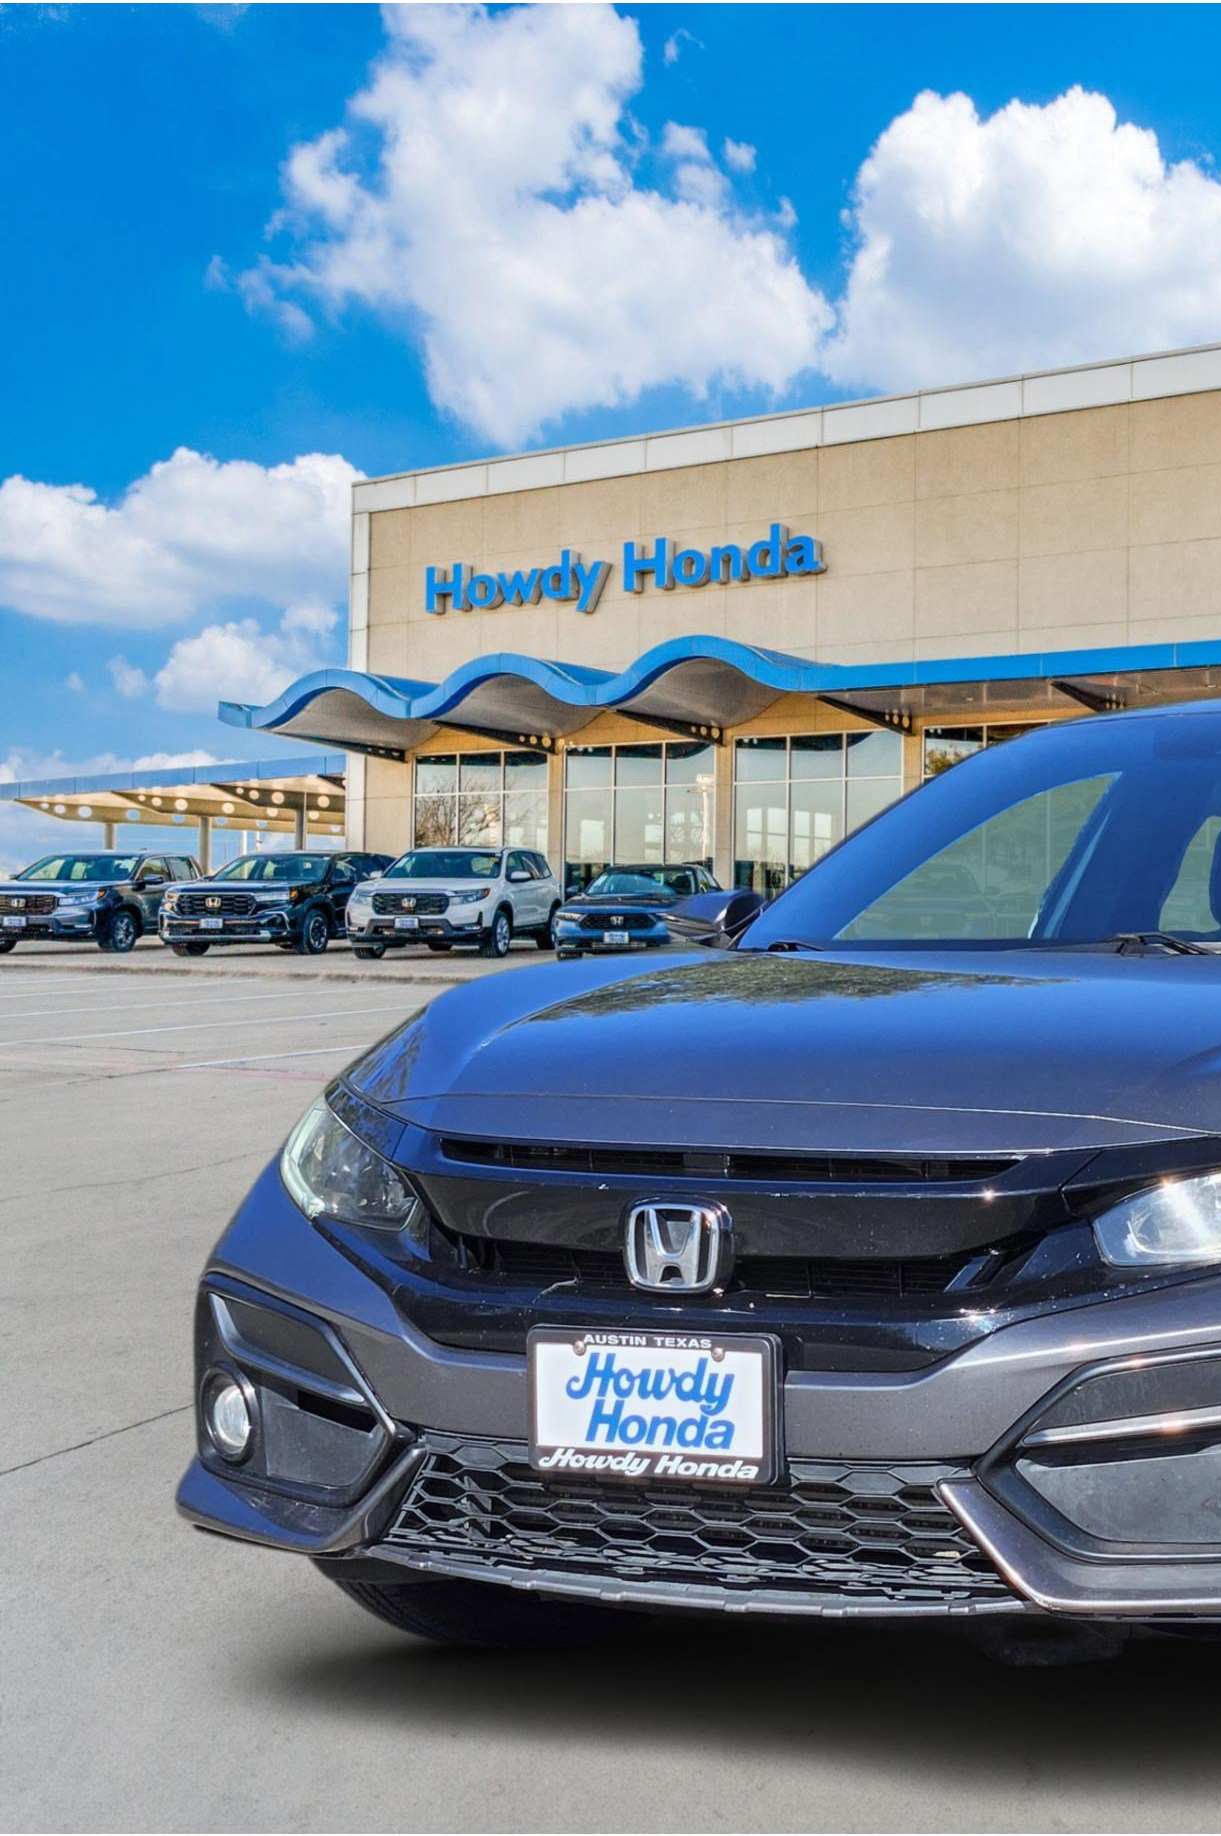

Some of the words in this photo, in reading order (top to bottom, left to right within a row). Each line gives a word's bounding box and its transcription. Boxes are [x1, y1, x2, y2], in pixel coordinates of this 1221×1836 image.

[425, 548, 612, 614] Howdy
[623, 523, 827, 594] Honda
[583, 1333, 647, 1347] AUSTIN
[653, 1336, 713, 1349] TEXAS
[565, 1352, 736, 1417] Howdy
[585, 1398, 736, 1450] Honda
[538, 1447, 652, 1477] Howdy
[653, 1455, 760, 1480] Honda
